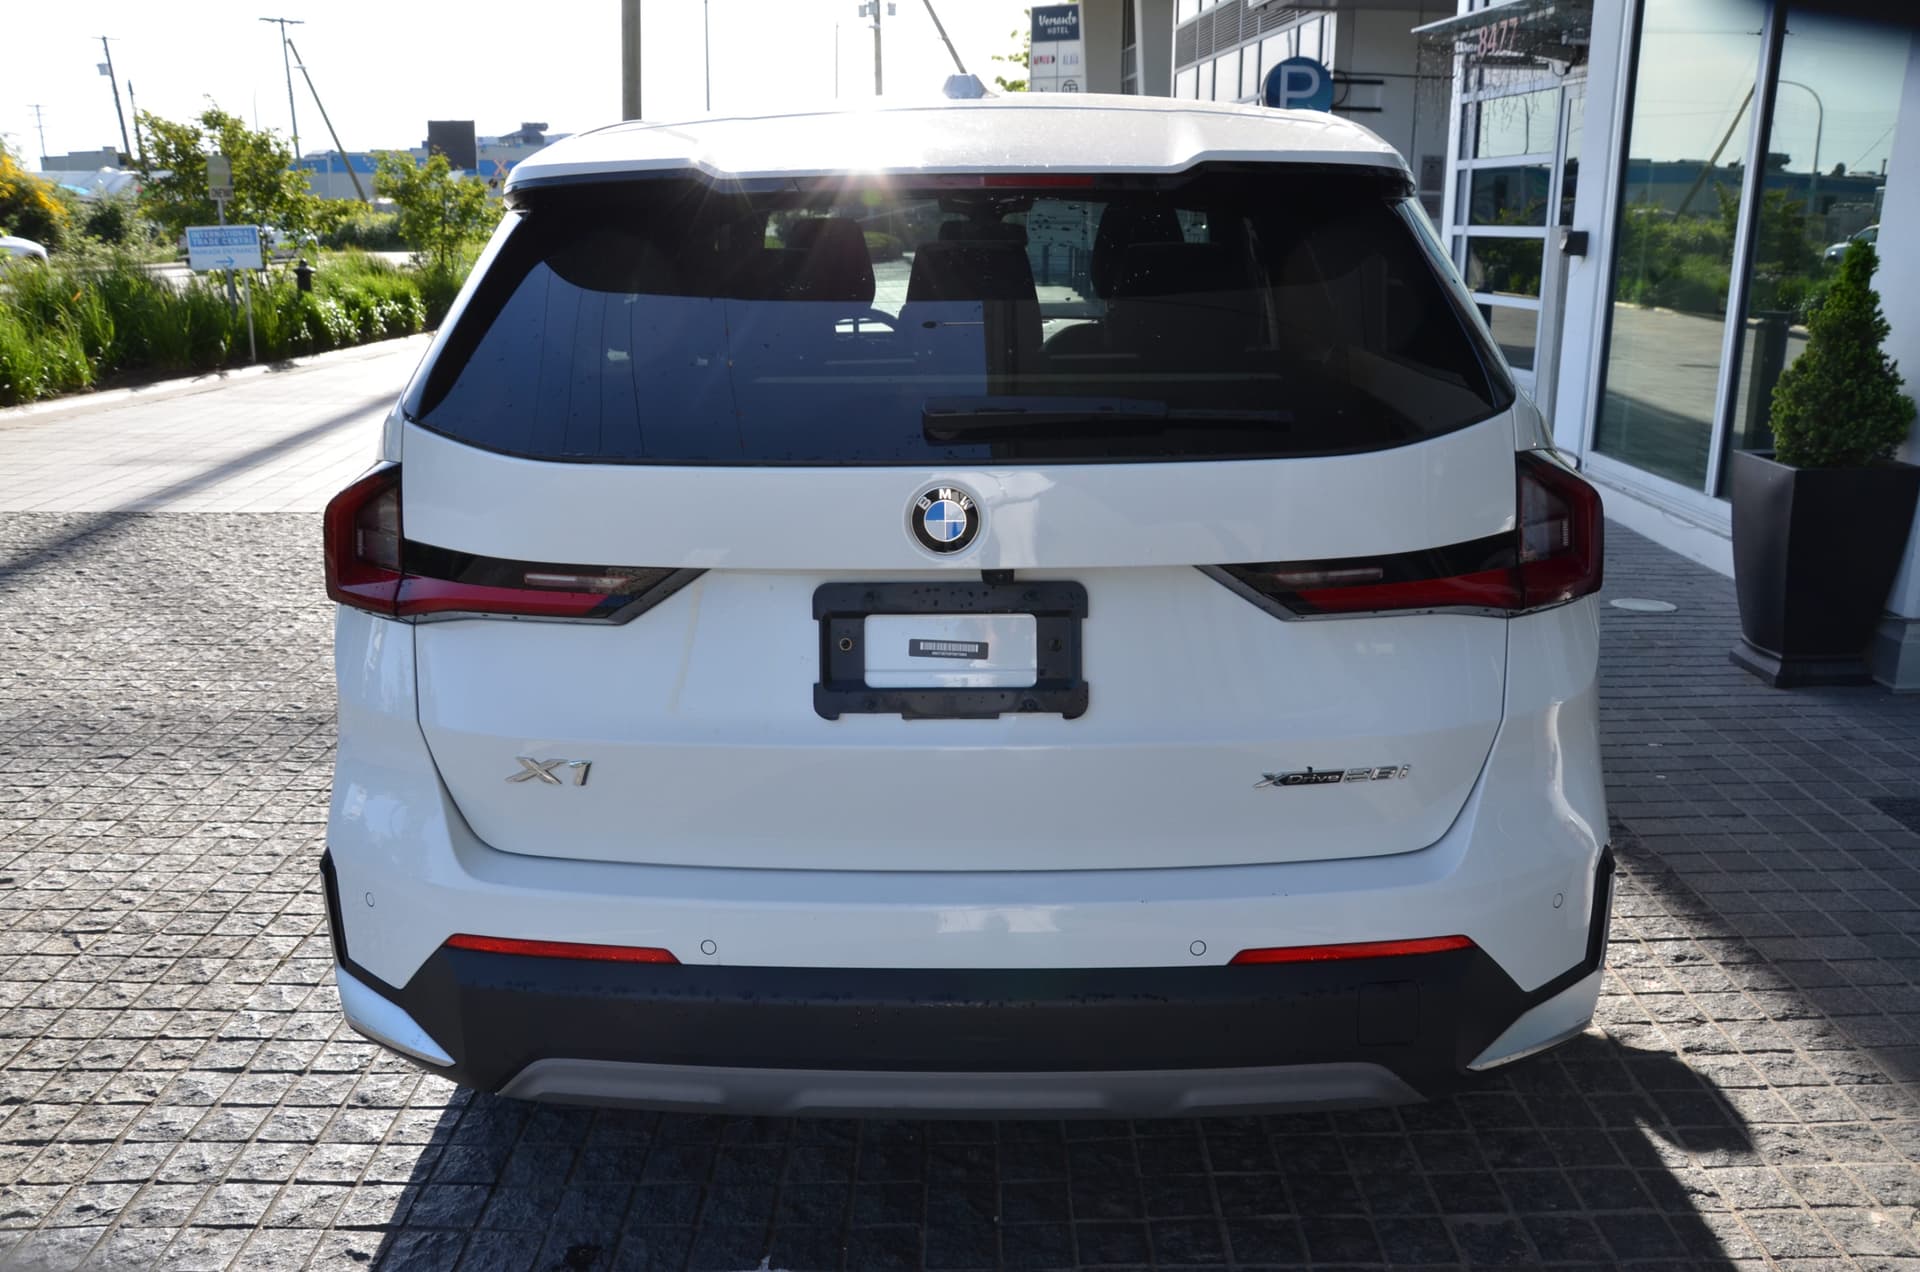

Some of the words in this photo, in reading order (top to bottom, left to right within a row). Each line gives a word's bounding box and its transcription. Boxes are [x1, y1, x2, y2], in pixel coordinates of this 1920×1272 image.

[1477, 17, 1518, 58] 8477
[1280, 65, 1320, 109] P
[190, 228, 252, 239] INTERNATIONAL
[192, 238, 220, 247] TRADE
[918, 488, 974, 511] BMW
[504, 756, 592, 786] X1
